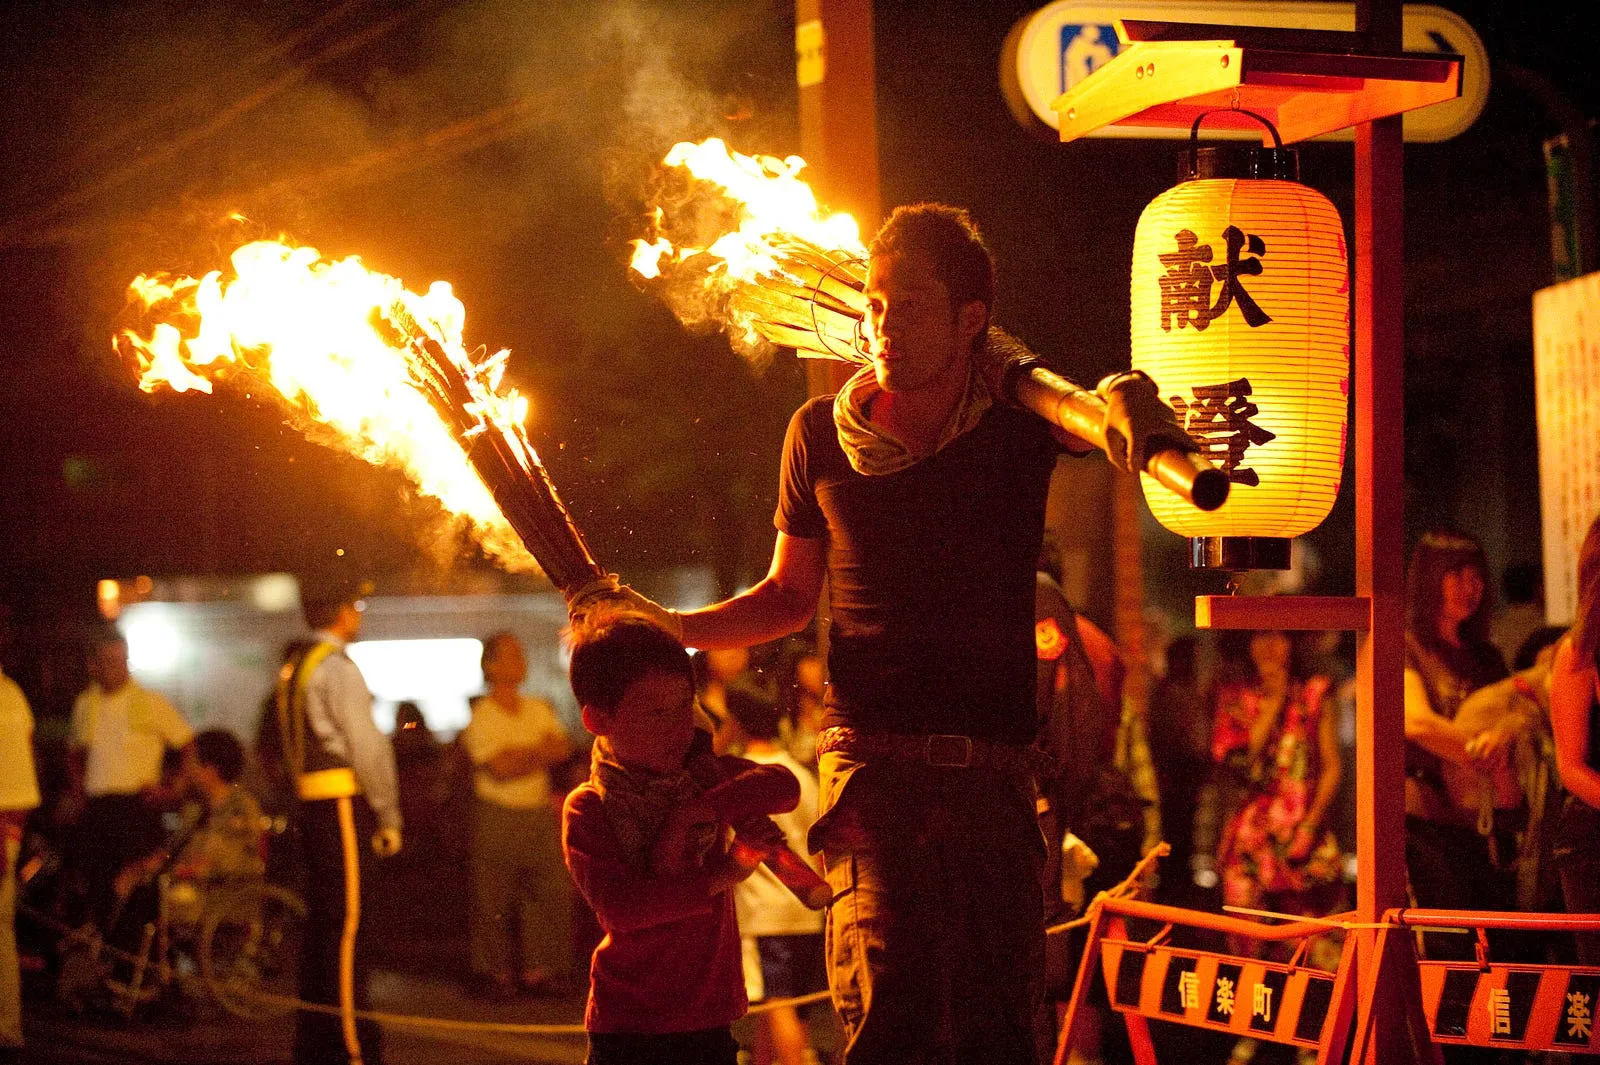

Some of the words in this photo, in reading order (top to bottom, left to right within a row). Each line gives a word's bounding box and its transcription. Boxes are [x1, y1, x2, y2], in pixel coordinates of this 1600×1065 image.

[1178, 970, 1273, 1022] 信楽町
[1487, 988, 1593, 1038] 信楽
